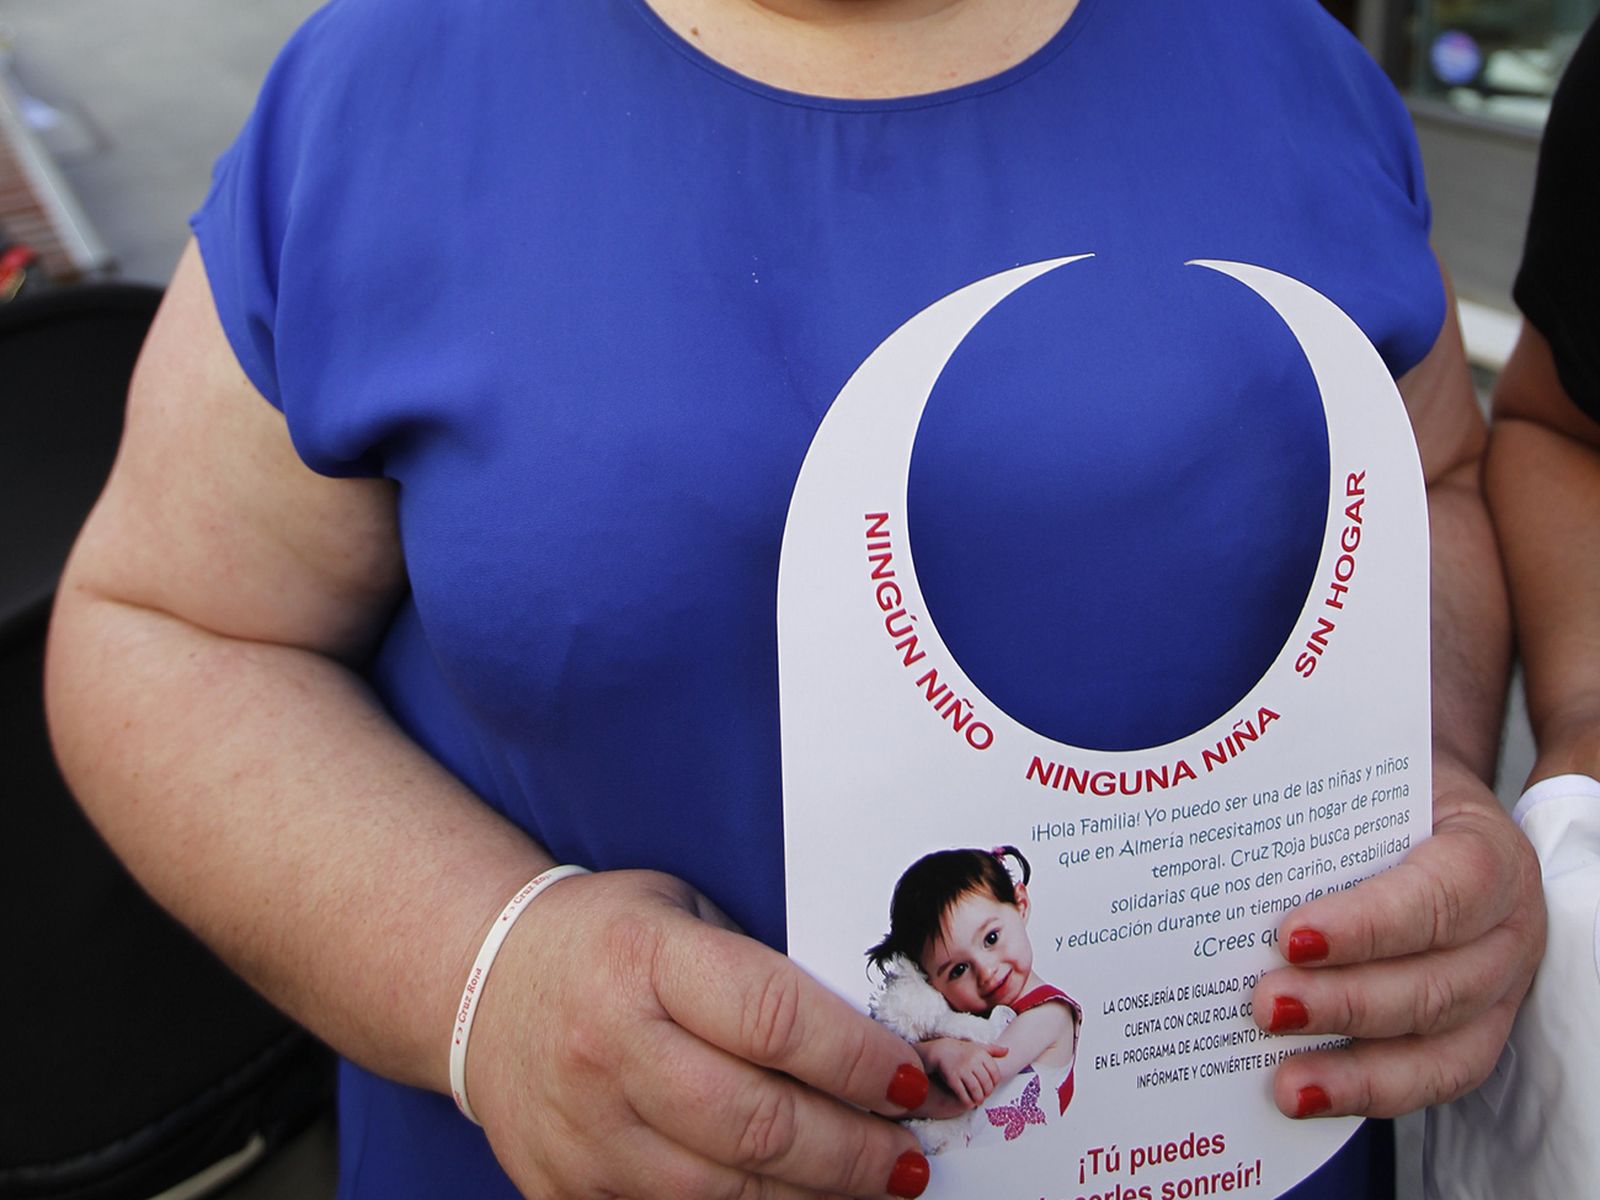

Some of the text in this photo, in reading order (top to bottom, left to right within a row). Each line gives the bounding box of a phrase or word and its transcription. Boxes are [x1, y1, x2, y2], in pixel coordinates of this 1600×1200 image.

[865, 470, 1366, 796] NINGÚN NIÑO NINGUNA NIÑA SIN HOGAR
[1031, 755, 1409, 842] ¡Hola Familia! Yo puedo ser una de las niñas y niños
[1058, 783, 1409, 868] que en Almería necesitamos un hogar de forma
[1152, 809, 1410, 879] temporal. Cruz Roja busca personas
[1110, 888, 1186, 914] solidarias
[1190, 882, 1220, 902] que
[1225, 878, 1250, 894] nos
[1255, 870, 1283, 888] den
[1287, 858, 1336, 881] cariño,
[1340, 833, 1410, 868] estabilidad
[1055, 936, 1063, 951] y
[1067, 920, 1152, 947] educación
[1157, 909, 1221, 933] durante
[1226, 905, 1245, 921] un
[1250, 893, 1301, 915] tiempo
[1194, 930, 1256, 958] ¿Crees
[458, 995, 472, 1023] Cruz
[1103, 999, 1115, 1015] LA
[1117, 985, 1175, 1012] CONSEJERÍA
[1177, 986, 1189, 1001] DE
[1192, 978, 1241, 999] IGUALDAD,
[1124, 1019, 1161, 1038] CUENTA
[1163, 1014, 1184, 1030] CON
[1186, 1009, 1210, 1027] CRUZ
[1212, 1005, 1238, 1022] ROJA
[1095, 1056, 1108, 1070] EN
[1110, 1053, 1121, 1067] EL
[1123, 1043, 1176, 1065] PROGRAMA
[1178, 1040, 1190, 1055] DE
[1193, 1028, 1257, 1052] ACOGIMIENTO
[1136, 1067, 1189, 1089] INFÓRMATE
[1191, 1065, 1198, 1079] Y
[1200, 1053, 1262, 1078] CONVIÉRTETE
[1264, 1052, 1276, 1068] EN
[1079, 1132, 1226, 1185] ¡Tú puedes
[1161, 1159, 1262, 1200] sonreír!
